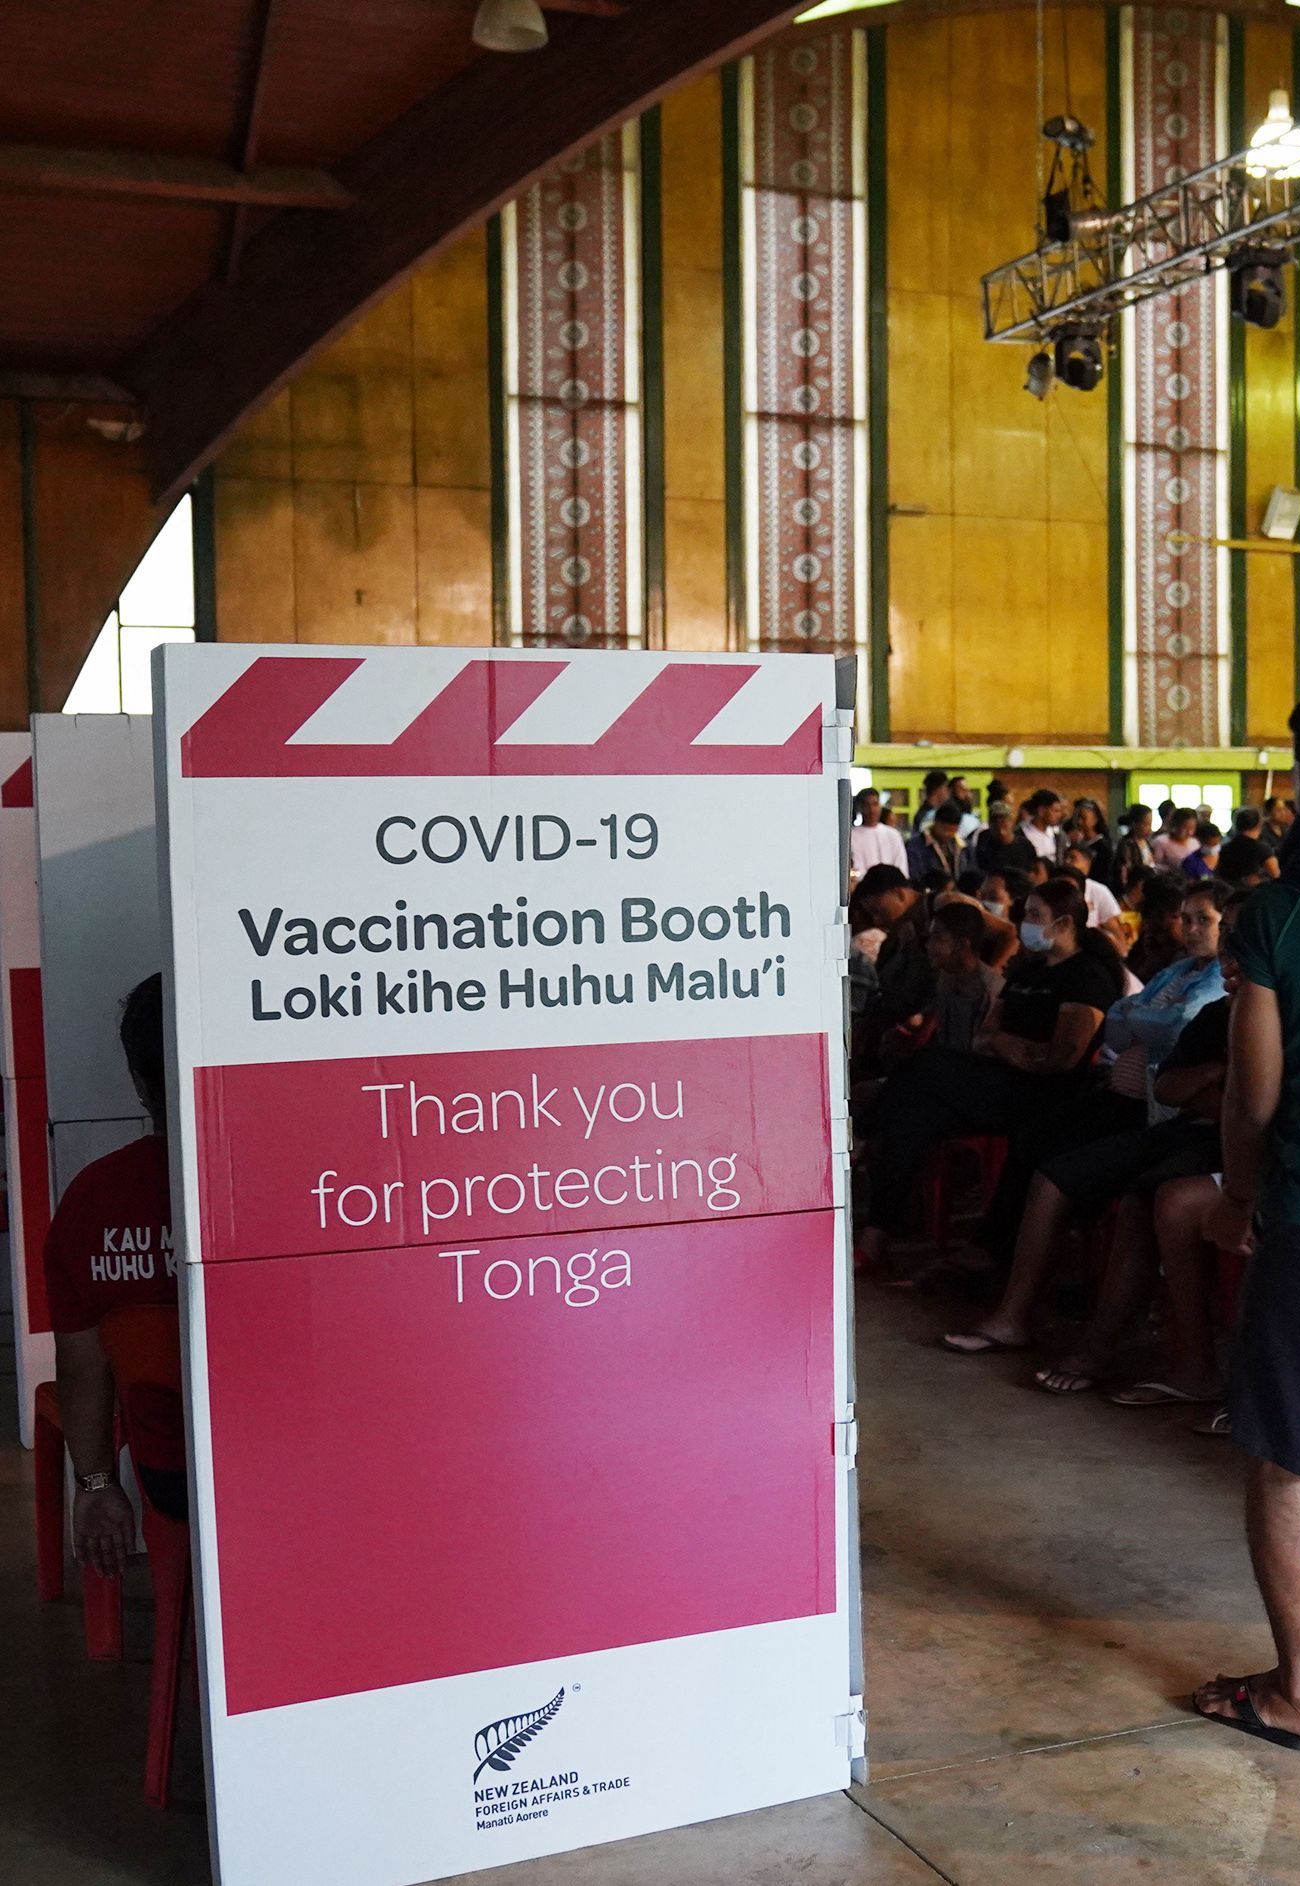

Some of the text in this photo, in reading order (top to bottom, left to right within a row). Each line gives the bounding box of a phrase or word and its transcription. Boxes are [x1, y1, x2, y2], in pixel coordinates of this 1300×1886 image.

[375, 812, 659, 865] COVID-19
[238, 891, 791, 957] Vaccination Booth
[251, 954, 785, 1021] Loki kihe Huhu Malu'i
[362, 1073, 684, 1139] Thank you
[311, 1148, 741, 1235] for protecting
[103, 1227, 151, 1252] KAU
[90, 1254, 155, 1281] HUHU
[438, 1247, 632, 1308] Tonga
[474, 1771, 579, 1803] NEW ZEALAND
[475, 1777, 631, 1817] FOREIGN AFFAIRS & TRADE
[516, 1809, 549, 1823] Aorere
